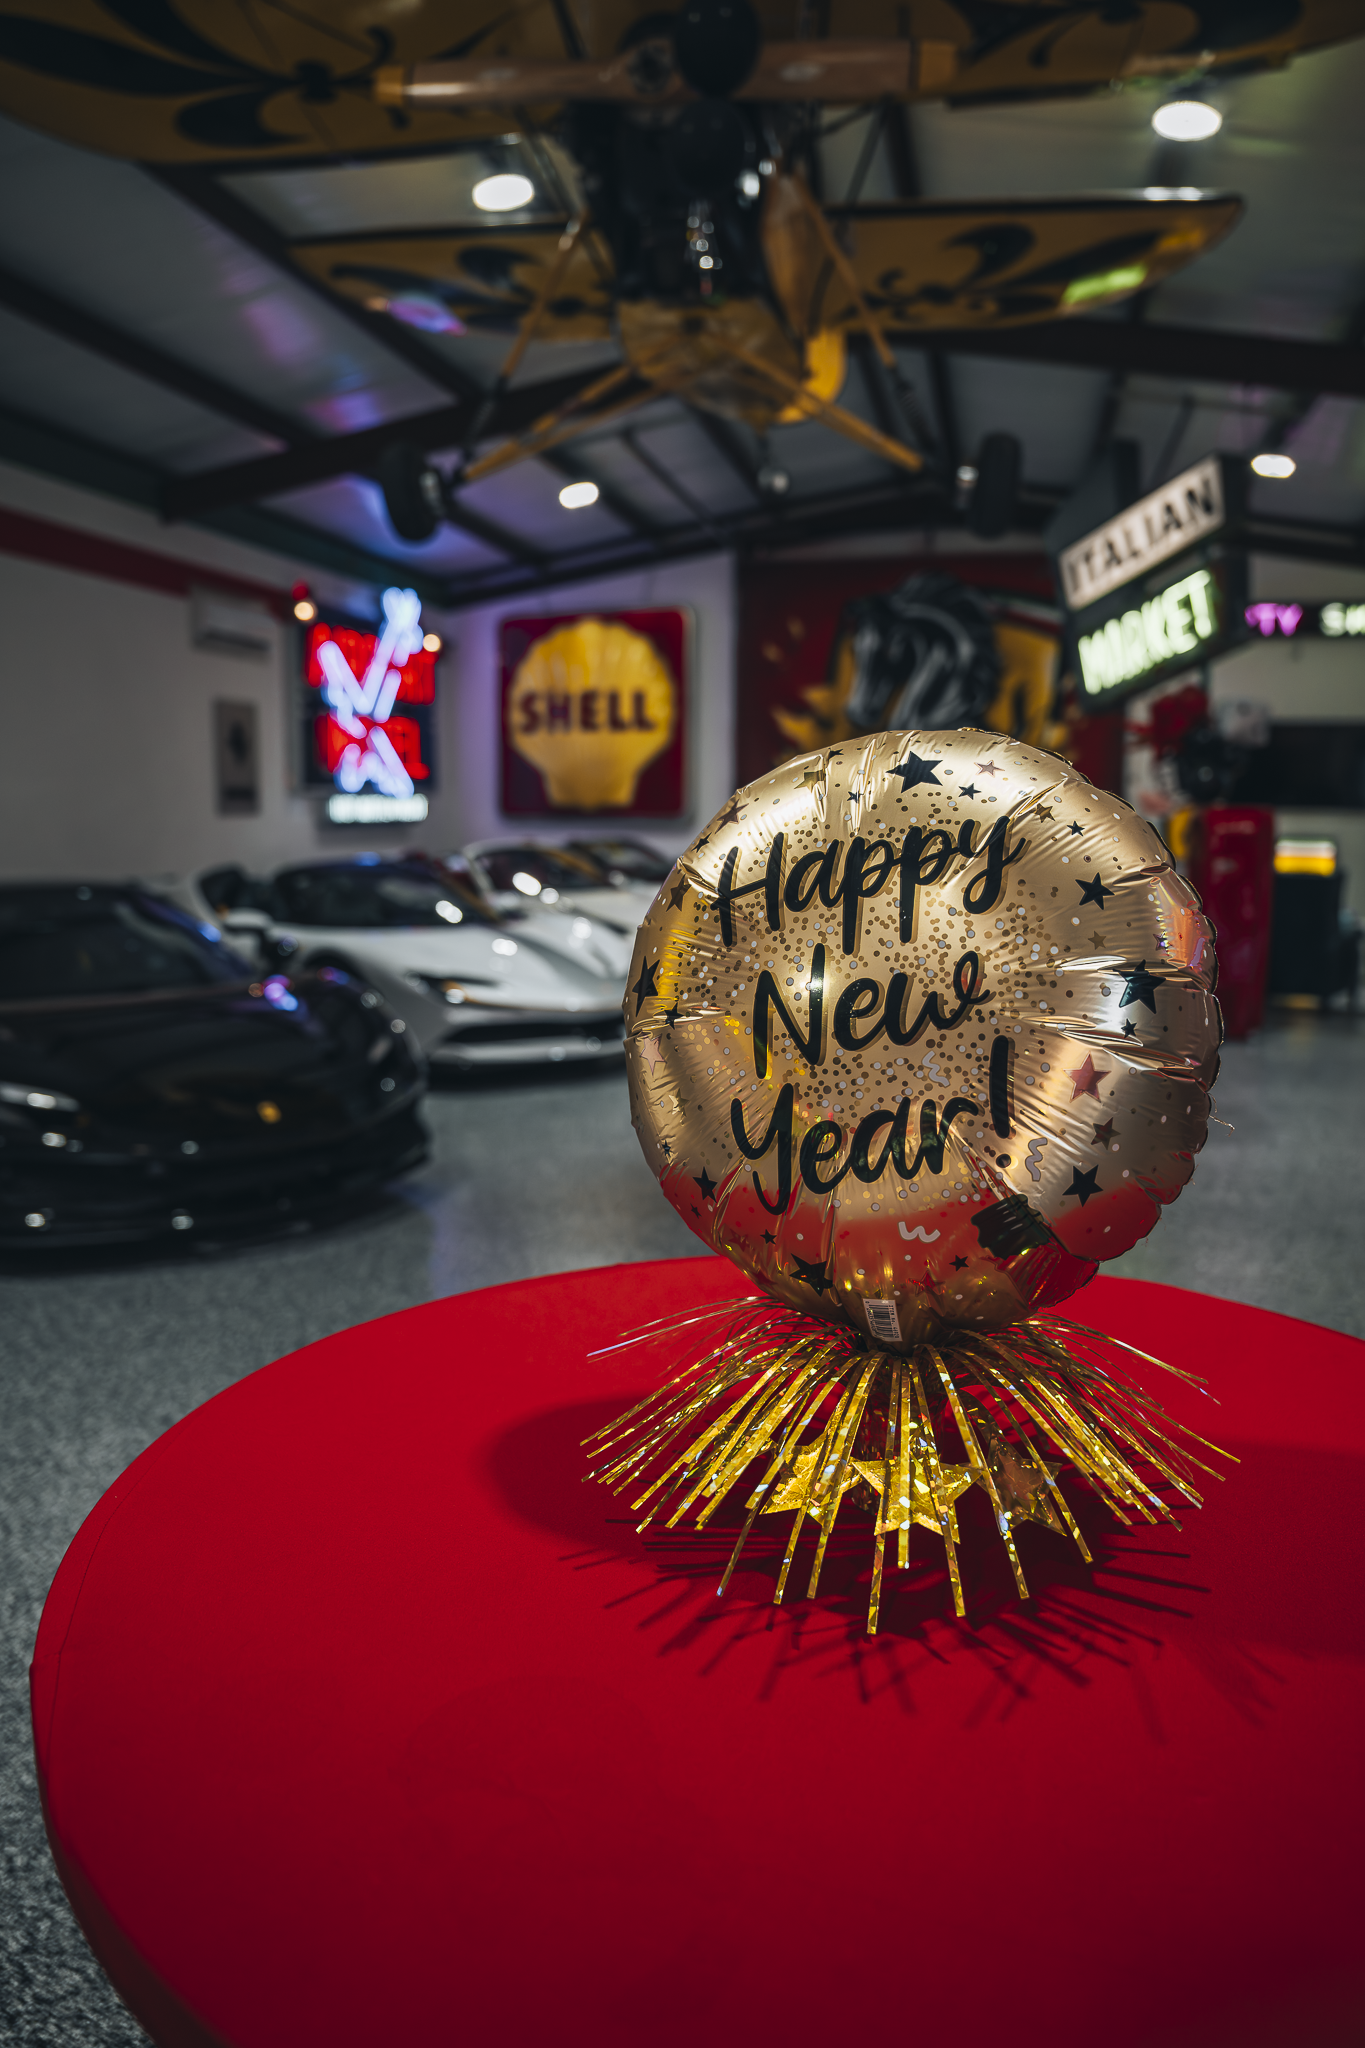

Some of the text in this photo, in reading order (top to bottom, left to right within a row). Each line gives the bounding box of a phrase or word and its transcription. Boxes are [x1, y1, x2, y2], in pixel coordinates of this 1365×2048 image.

[1067, 477, 1214, 593] ITALIAN
[1078, 569, 1213, 695] MARKET
[518, 689, 658, 736] SHELL
[710, 815, 1026, 956] Happy
[752, 942, 991, 1080] New
[730, 1034, 1012, 1217] Year!
